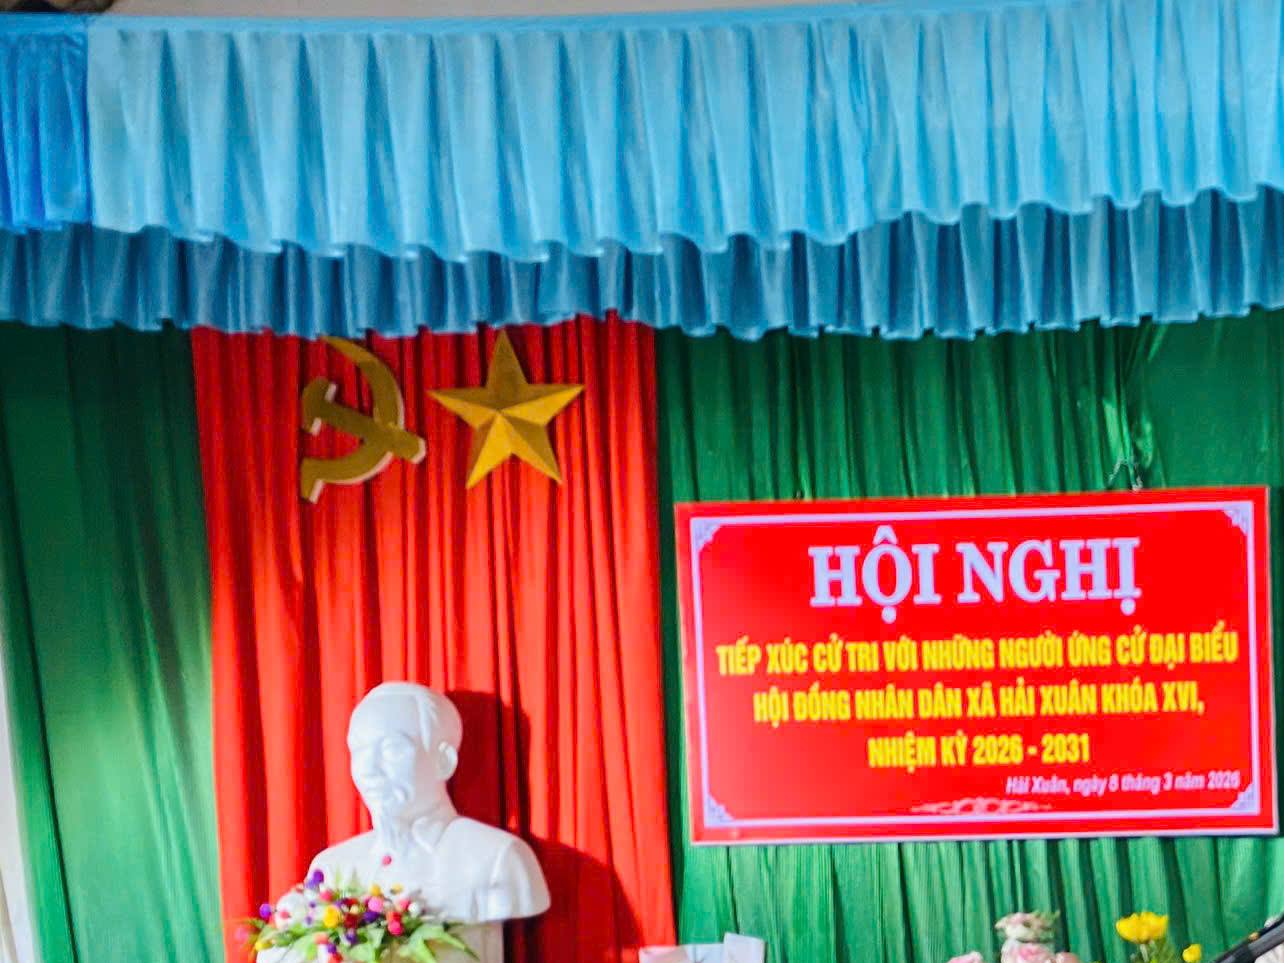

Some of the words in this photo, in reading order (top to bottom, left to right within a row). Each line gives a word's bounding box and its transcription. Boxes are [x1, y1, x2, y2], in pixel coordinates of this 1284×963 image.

[808, 525, 942, 624] HỘI
[955, 536, 1142, 616] NGHỊ
[716, 635, 762, 676] TIẾP
[766, 637, 808, 675] XÚC
[846, 641, 880, 672] TRI
[753, 685, 790, 729] HỘI
[917, 681, 962, 718] DÂN
[1039, 678, 1098, 716] XUÂN
[1161, 680, 1205, 716] XVI,
[867, 730, 937, 771] NHIỆM
[971, 733, 1025, 766] 2026
[1041, 732, 1091, 764] 2031
